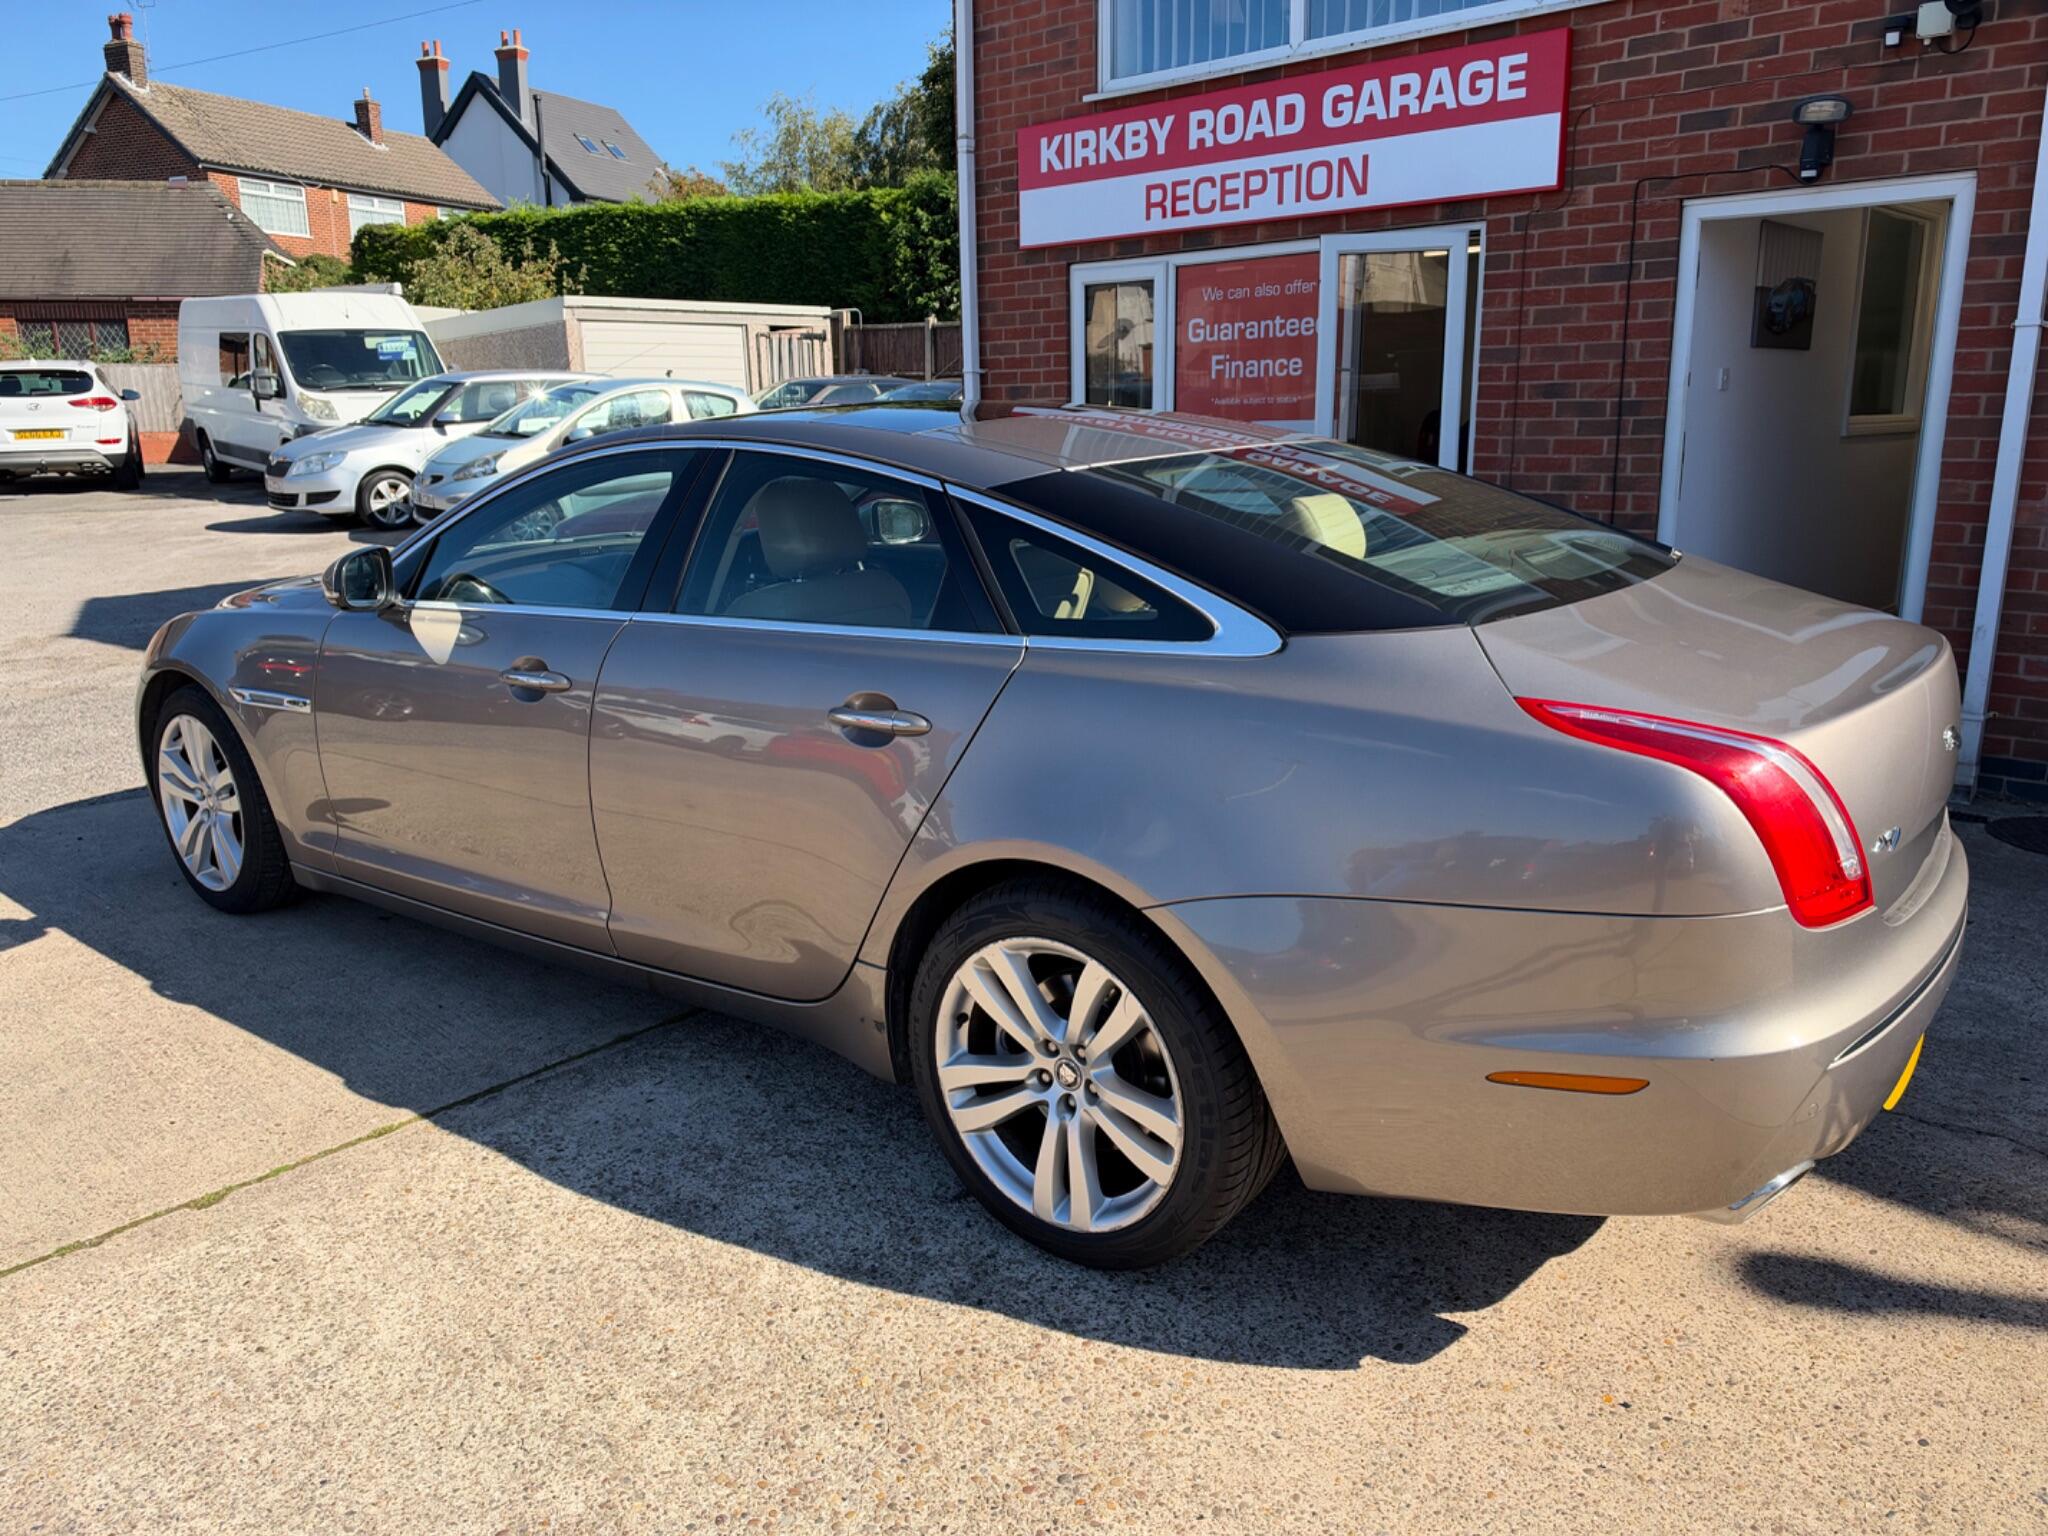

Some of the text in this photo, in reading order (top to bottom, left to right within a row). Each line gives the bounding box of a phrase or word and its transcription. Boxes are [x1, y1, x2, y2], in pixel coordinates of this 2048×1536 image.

[1040, 53, 1529, 173] KIRKBY ROAD GARAGE
[1145, 154, 1370, 221] RECEPTION
[1202, 279, 1316, 301] We can also offer
[1187, 315, 1319, 343] Guarantee
[1210, 354, 1303, 380] Finance
